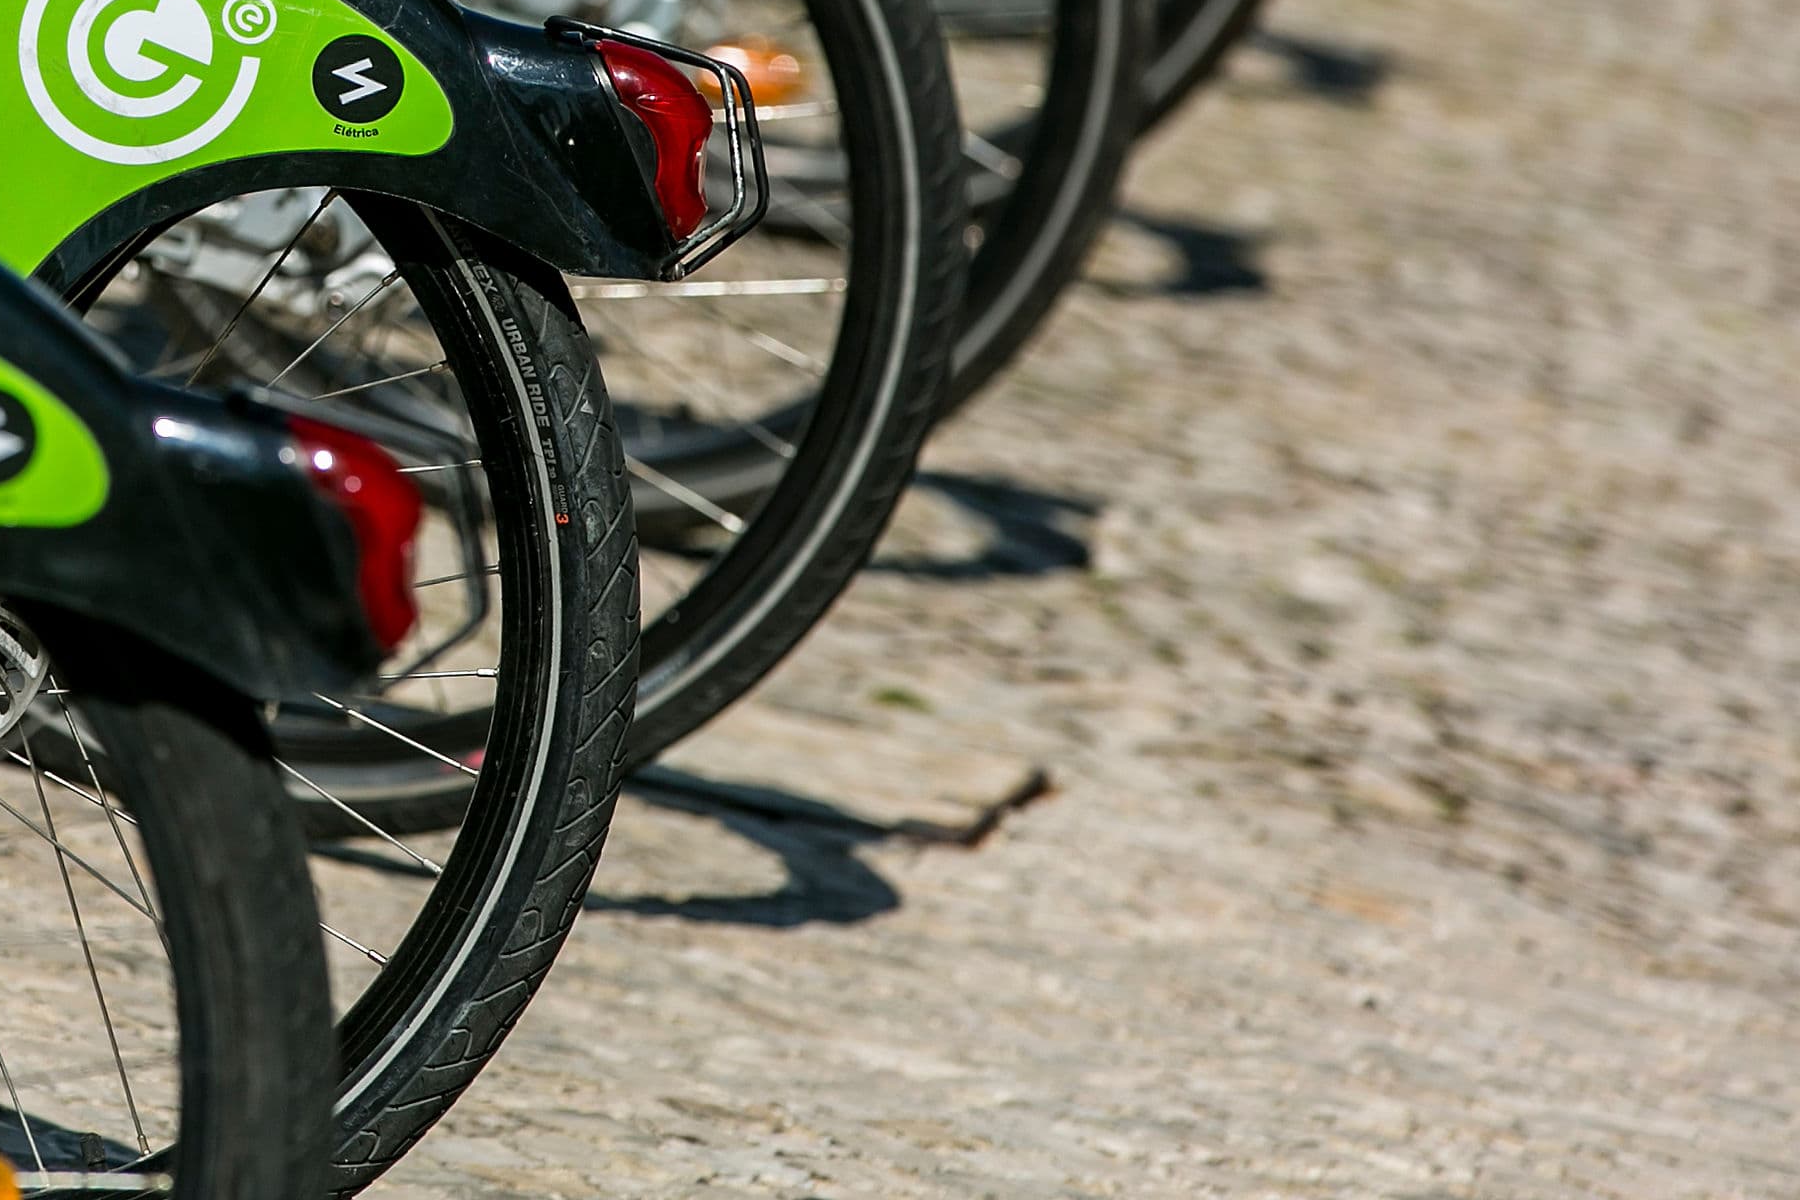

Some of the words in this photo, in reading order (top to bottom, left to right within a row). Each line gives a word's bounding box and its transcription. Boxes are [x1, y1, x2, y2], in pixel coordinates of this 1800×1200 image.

[333, 123, 379, 138] Elétrica
[501, 317, 537, 379] URBAN
[527, 383, 551, 428] RIDE
[542, 438, 557, 465] TPI
